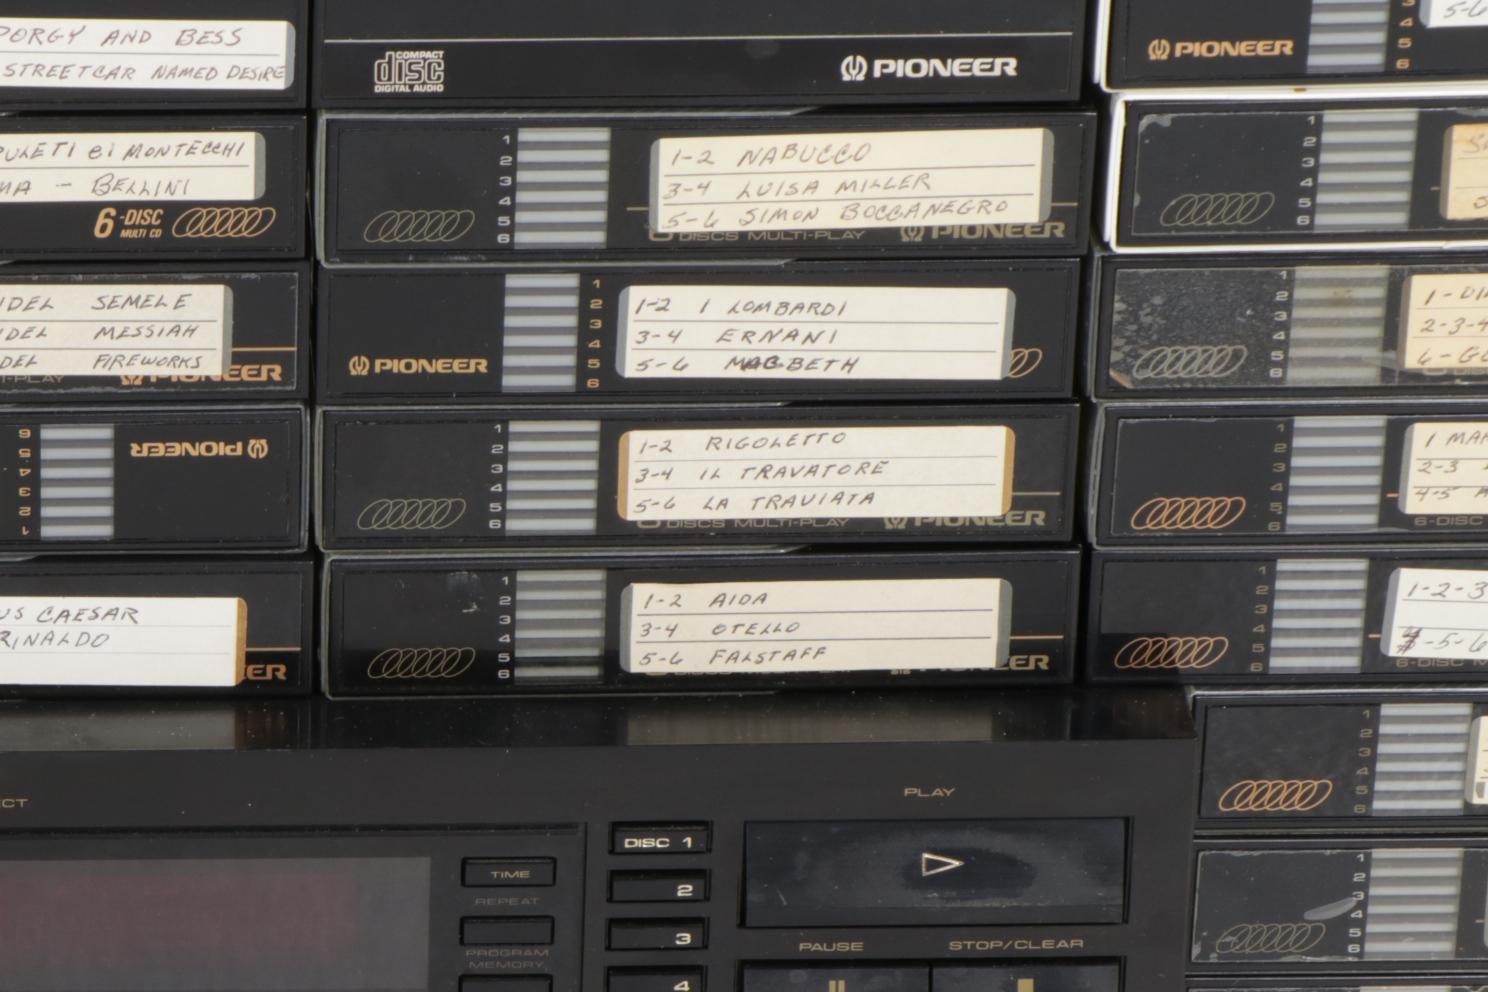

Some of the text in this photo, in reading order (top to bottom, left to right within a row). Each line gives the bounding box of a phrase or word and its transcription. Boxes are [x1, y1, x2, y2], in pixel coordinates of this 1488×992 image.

[101, 29, 153, 46] AND
[175, 26, 243, 47] BESS
[396, 51, 444, 59] COMPACT
[1175, 40, 1294, 57] PIONEER
[150, 63, 218, 82] NAMED
[226, 63, 286, 82] DESIRE
[873, 56, 1018, 78] PIONEER
[374, 84, 444, 93] DIGITAL AUDIO
[671, 143, 872, 168] 1-2 NABUCCO
[92, 172, 191, 198] BELLINI
[663, 173, 931, 201] 3-4 LUISA MILLER
[738, 206, 820, 224] SIMON
[120, 228, 147, 239] MULTI
[748, 230, 865, 241] MULTI-PLAY
[91, 293, 193, 312] SEMELE
[635, 298, 847, 317] 1-2 LOMBARDI
[92, 325, 201, 340] MESSIAH
[635, 329, 838, 346] 3-4 ERNANI
[92, 353, 203, 371] FIREWORKS
[374, 359, 488, 374] PIONEER
[635, 356, 689, 372] 5-6
[130, 441, 243, 457] PIONEER
[639, 431, 847, 455] 1-2 RIGOLETTO
[635, 467, 673, 484] 3-4
[634, 491, 876, 514] 5-6 LA TRAVIATA
[644, 592, 768, 609] 1-2 AIDA
[36, 606, 139, 625] CAESAR
[640, 621, 801, 638] 3-4 OTELLO
[639, 646, 827, 666] 5-6 FALSTAFF
[904, 788, 955, 798] PLAY
[624, 837, 692, 849] DISC 1
[491, 871, 530, 879] TIME
[676, 884, 693, 896] 2
[675, 933, 692, 945] 3
[799, 942, 864, 952] PAUSE
[949, 939, 1084, 952] STOP/CLEAR
[673, 980, 690, 992] 4
